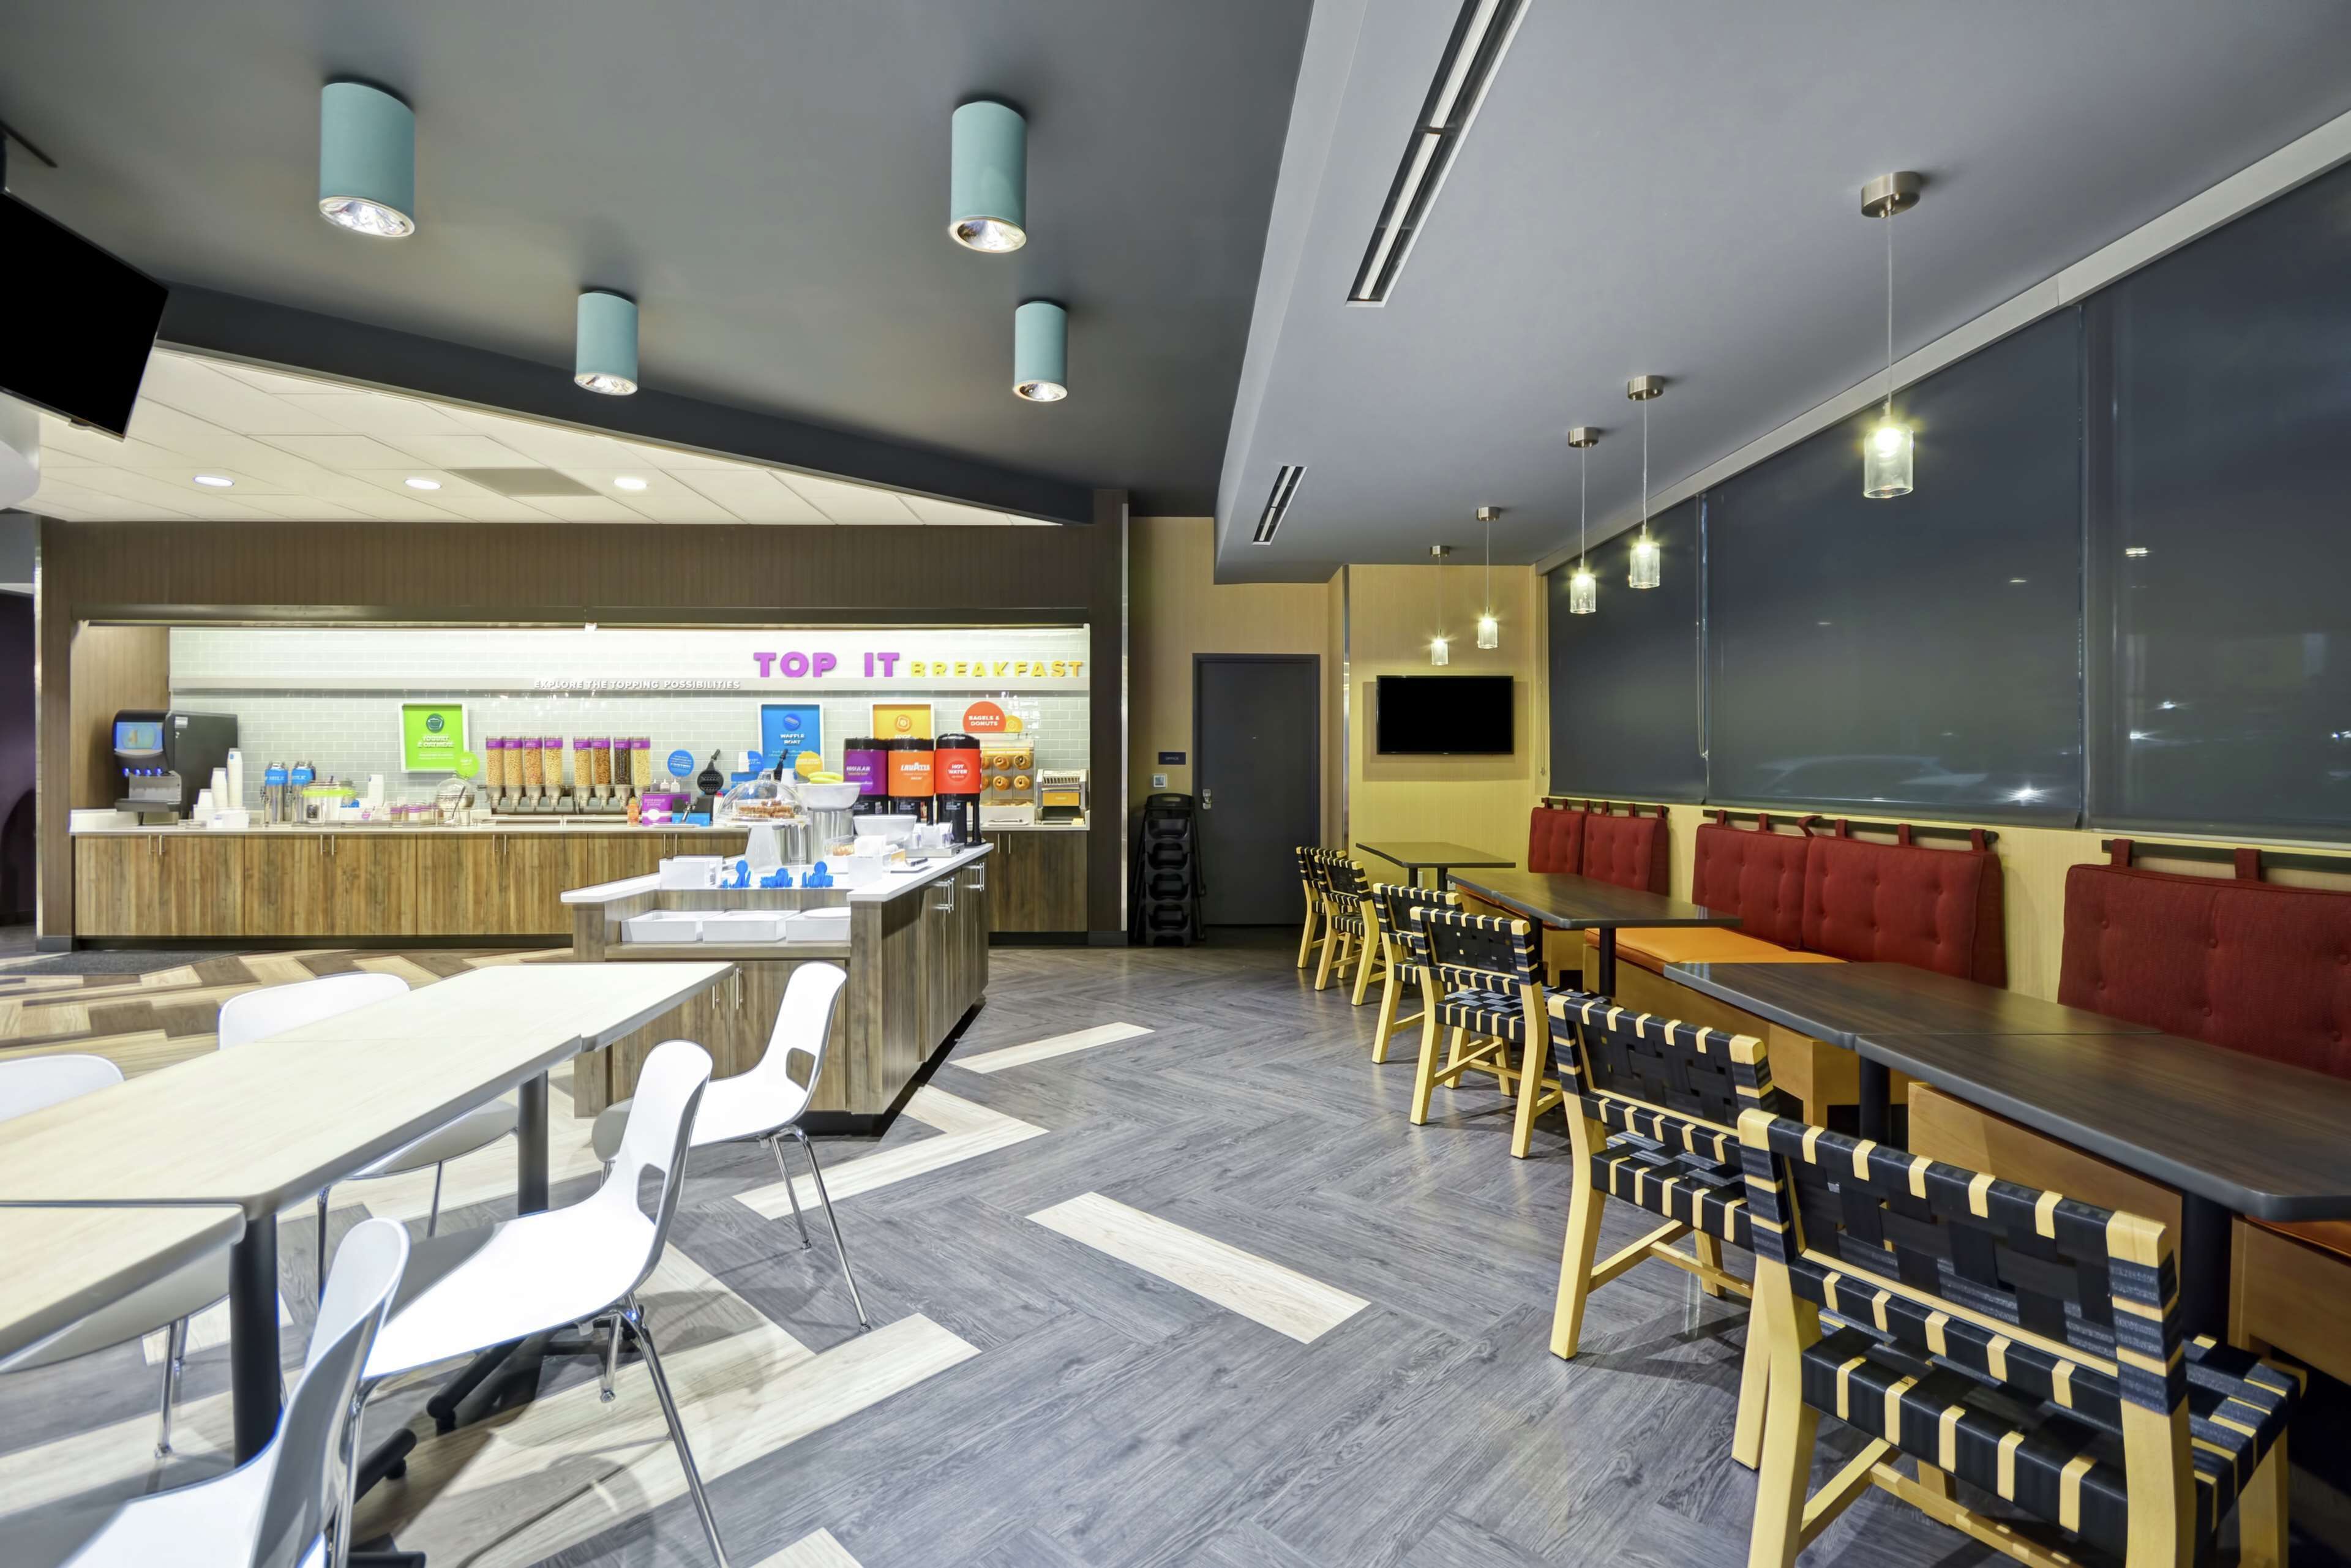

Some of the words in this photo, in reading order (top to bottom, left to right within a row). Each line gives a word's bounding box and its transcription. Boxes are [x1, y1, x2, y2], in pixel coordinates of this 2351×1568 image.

[753, 651, 837, 678] TOP
[864, 652, 900, 677] IT
[910, 661, 1083, 677] BREAKFAST
[534, 680, 582, 689] EXPLORE
[586, 680, 608, 689] THE
[610, 680, 659, 689] TOPPING
[664, 680, 740, 689] POSSIBILITIES
